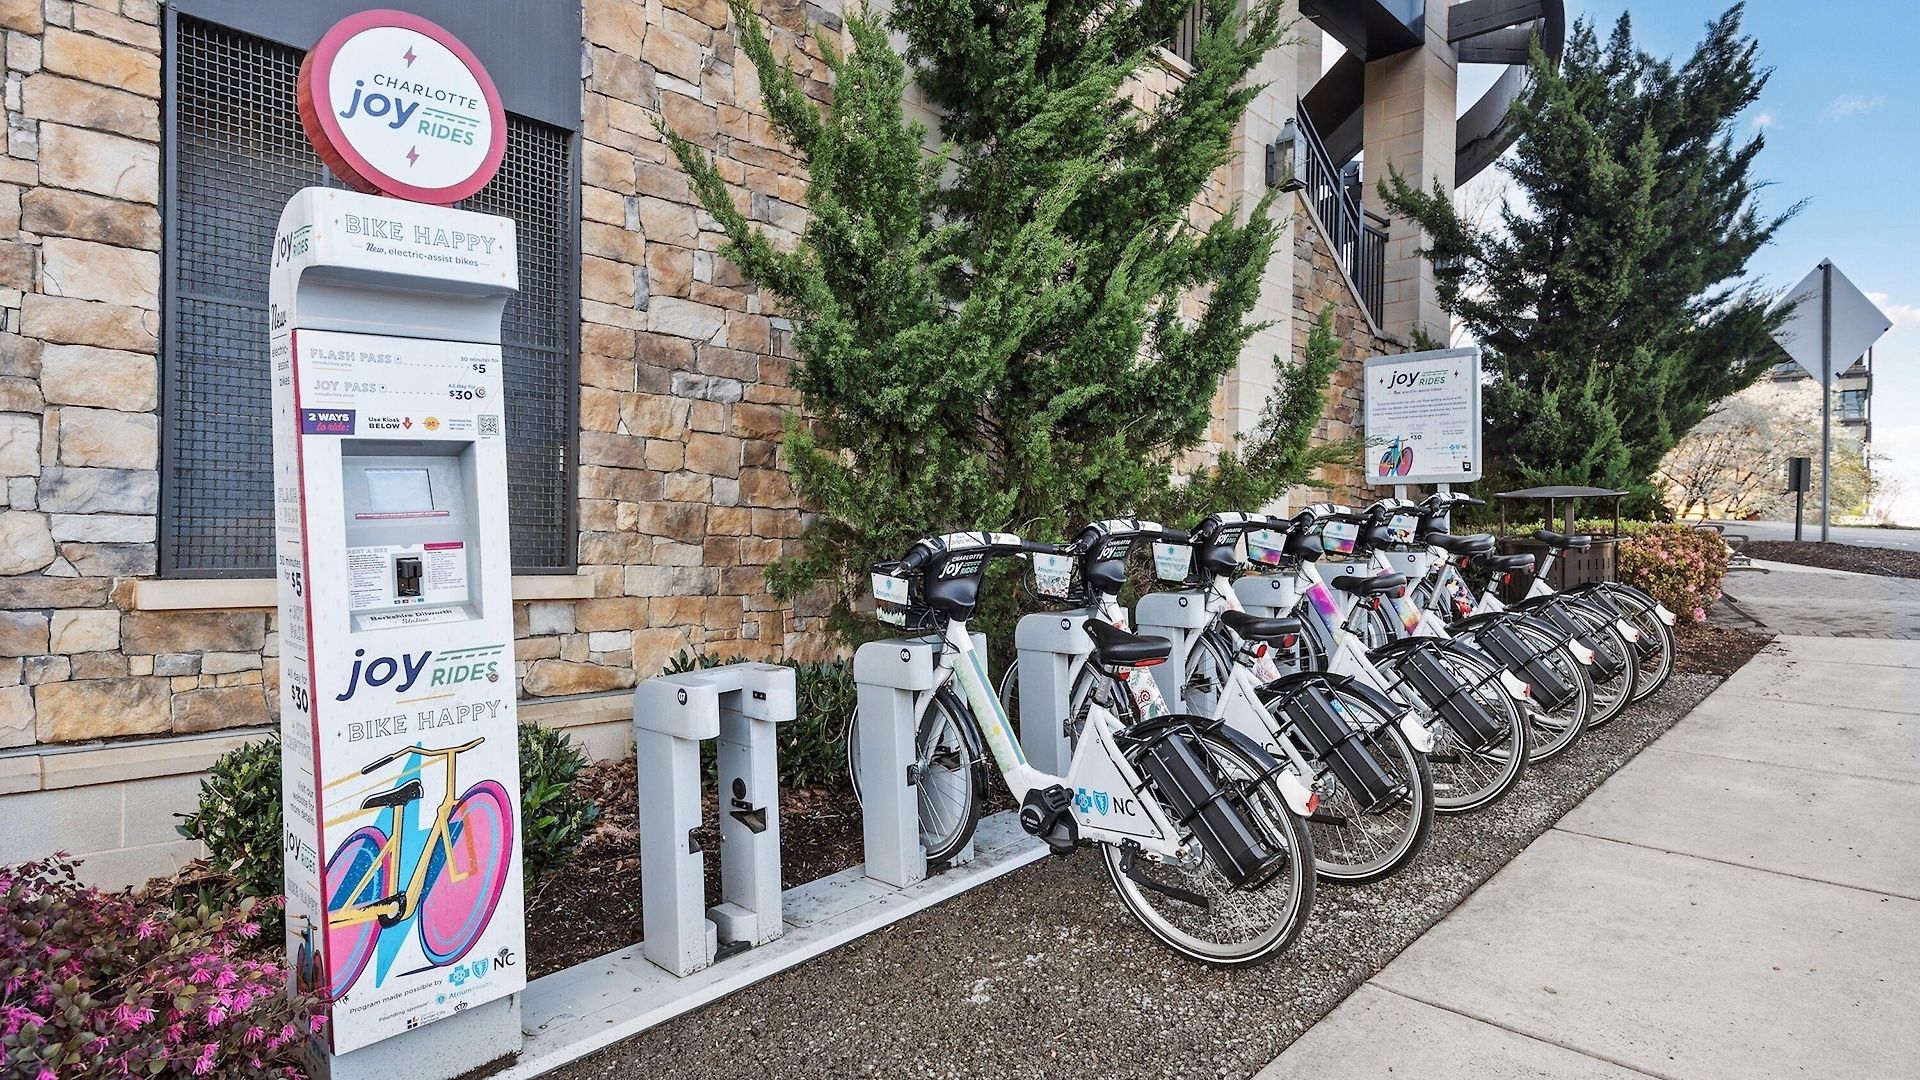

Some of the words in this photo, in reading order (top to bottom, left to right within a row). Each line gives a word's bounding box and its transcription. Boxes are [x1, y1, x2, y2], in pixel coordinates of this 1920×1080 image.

[373, 73, 478, 110] CHARLOTTE
[339, 79, 420, 130] joy
[417, 119, 474, 146] RIDES
[345, 213, 404, 242] BIKE
[413, 225, 496, 254] HAPPY
[276, 231, 293, 267] joy
[293, 238, 309, 257] RIDES
[388, 248, 453, 264] electric-assist
[455, 256, 479, 267] bikes
[310, 348, 355, 361] FLASH
[359, 352, 392, 364] PASS
[472, 363, 486, 374] $5
[314, 380, 339, 391] JOY
[344, 381, 376, 393] PASS
[1387, 371, 1420, 389] joy
[1419, 377, 1445, 386] RIDES
[449, 390, 473, 400] $30
[308, 413, 317, 421] 2
[318, 413, 349, 422] WAYS
[316, 422, 327, 431] to
[951, 554, 984, 562] CHARLOTTE
[1096, 545, 1116, 560] joy
[938, 561, 964, 579] joy
[960, 566, 979, 575] RIDES
[291, 572, 302, 597] $5
[370, 613, 414, 621] Berkshire
[415, 609, 453, 617] Dilworth
[336, 649, 432, 702] joy
[431, 661, 498, 687] RIDES
[291, 684, 308, 714] $30
[348, 714, 407, 742] BIKE
[418, 700, 501, 731] HAPPY
[1261, 742, 1274, 752] C
[1113, 796, 1136, 816] NC
[285, 822, 301, 860] joy
[301, 853, 316, 875] RIDES
[493, 952, 516, 971] NC
[349, 1000, 381, 1015] Program
[382, 993, 402, 1003] made
[404, 983, 433, 997] possible
[448, 988, 472, 999] Atrium
[379, 1009, 406, 1022] Founding
